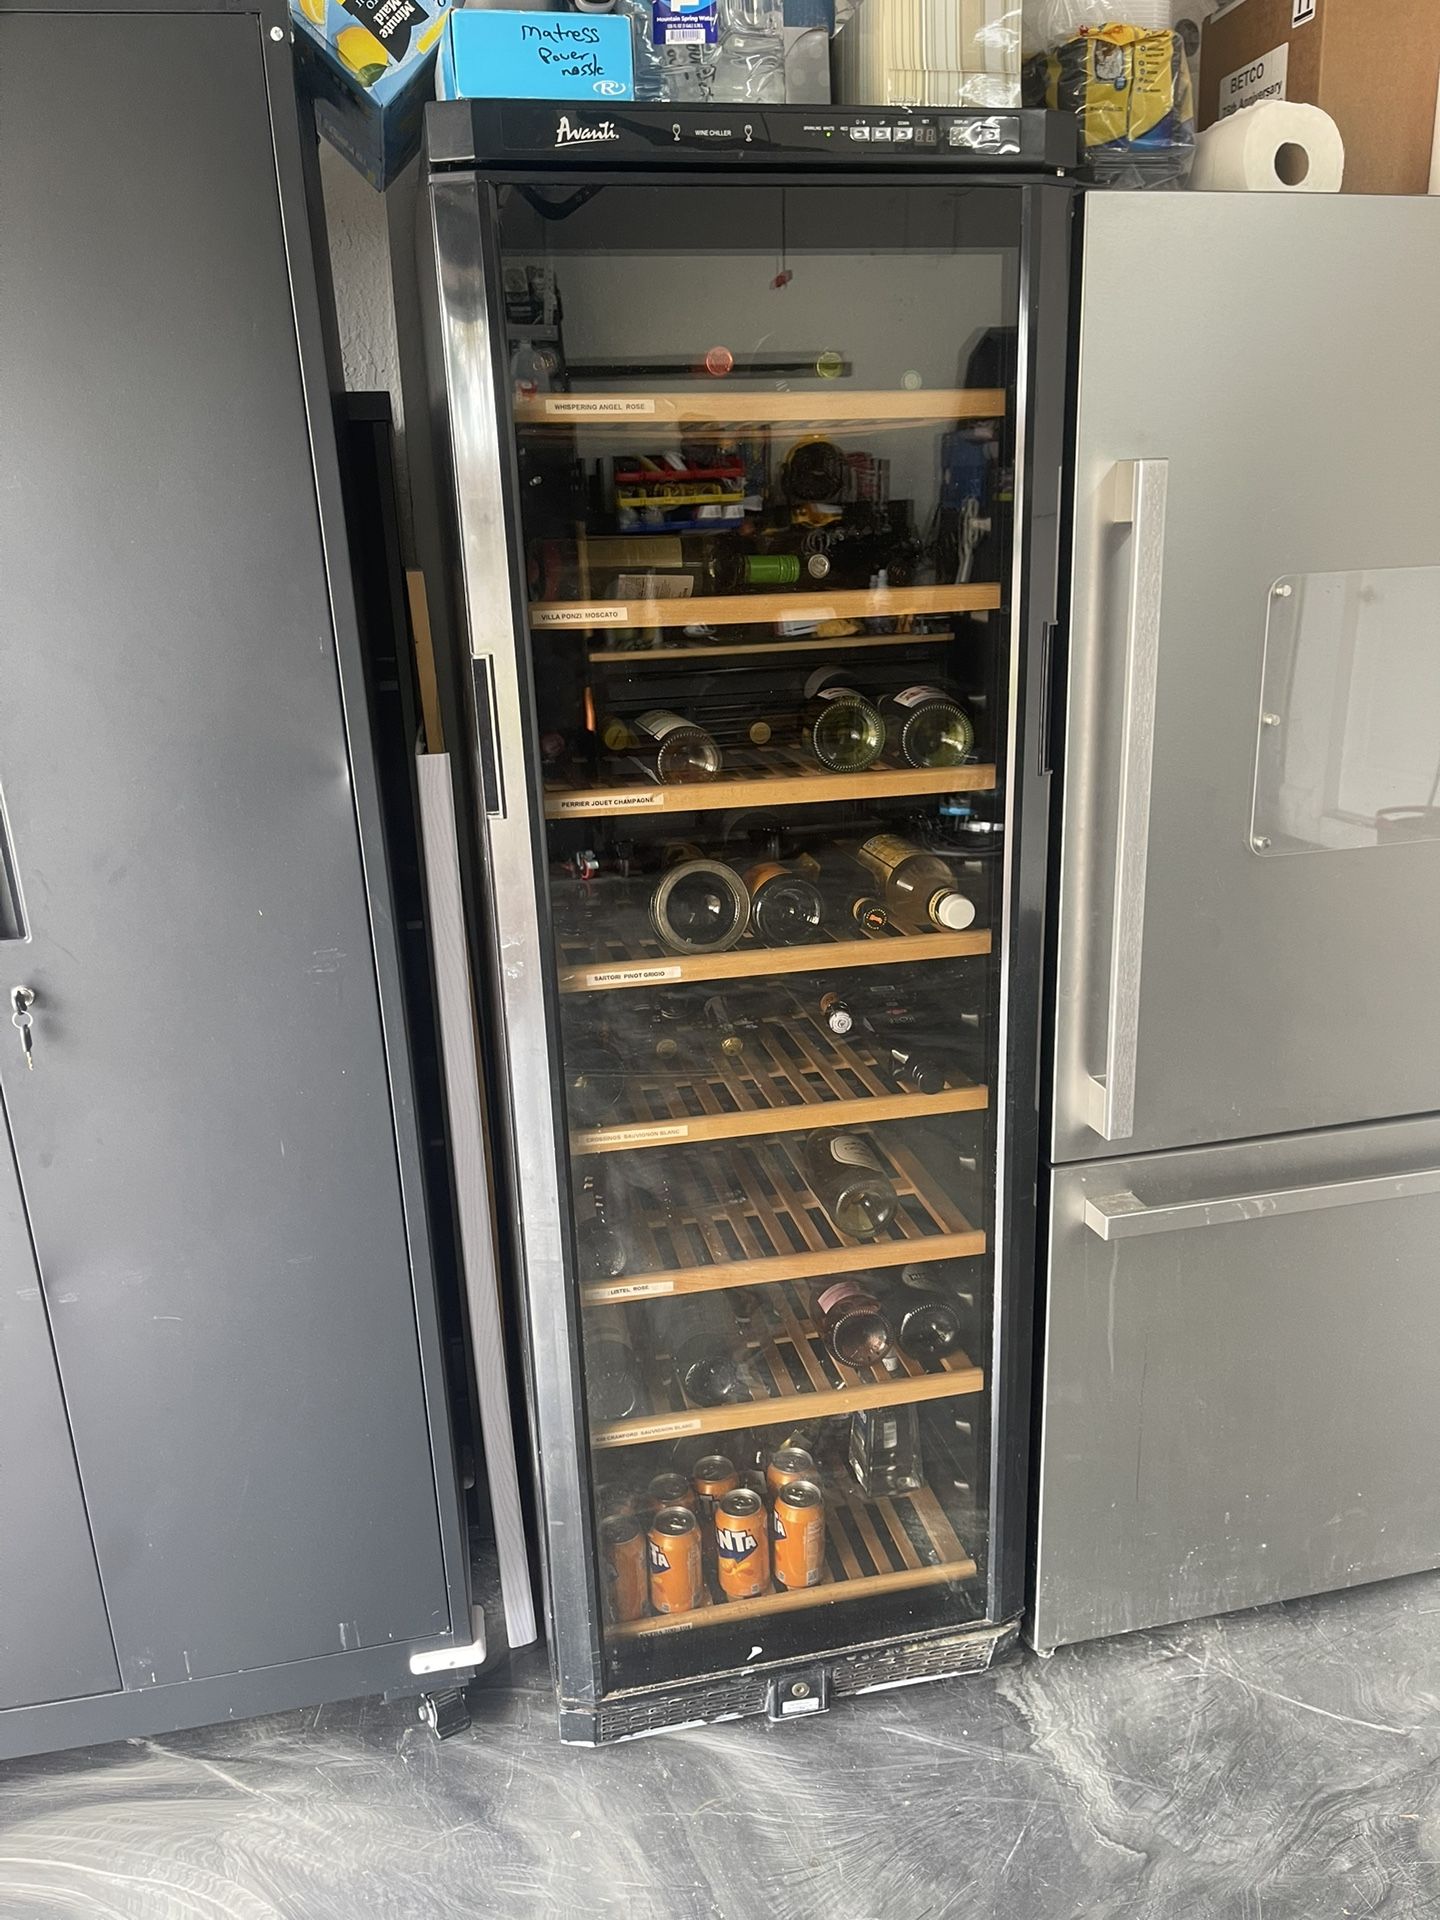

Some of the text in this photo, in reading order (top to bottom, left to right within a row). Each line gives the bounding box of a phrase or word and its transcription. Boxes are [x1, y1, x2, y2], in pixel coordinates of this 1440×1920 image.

[373, 0, 402, 26] Maid
[681, 14, 699, 23] Spring
[379, 1, 416, 39] Minute
[1230, 62, 1265, 94] BETCO
[694, 129, 732, 137] WINE CHILLER
[554, 402, 645, 411] WHISPERING ANGEL ROSE
[541, 613, 560, 621] VILLA
[584, 611, 618, 619] MOSCATO
[561, 797, 654, 808] PERRIER JOUET CHAMPAGNE
[594, 971, 666, 982] SARTORI PINOT GRIGIO
[623, 1131, 659, 1140] SAUVIGNON
[659, 1128, 680, 1136] BLANC
